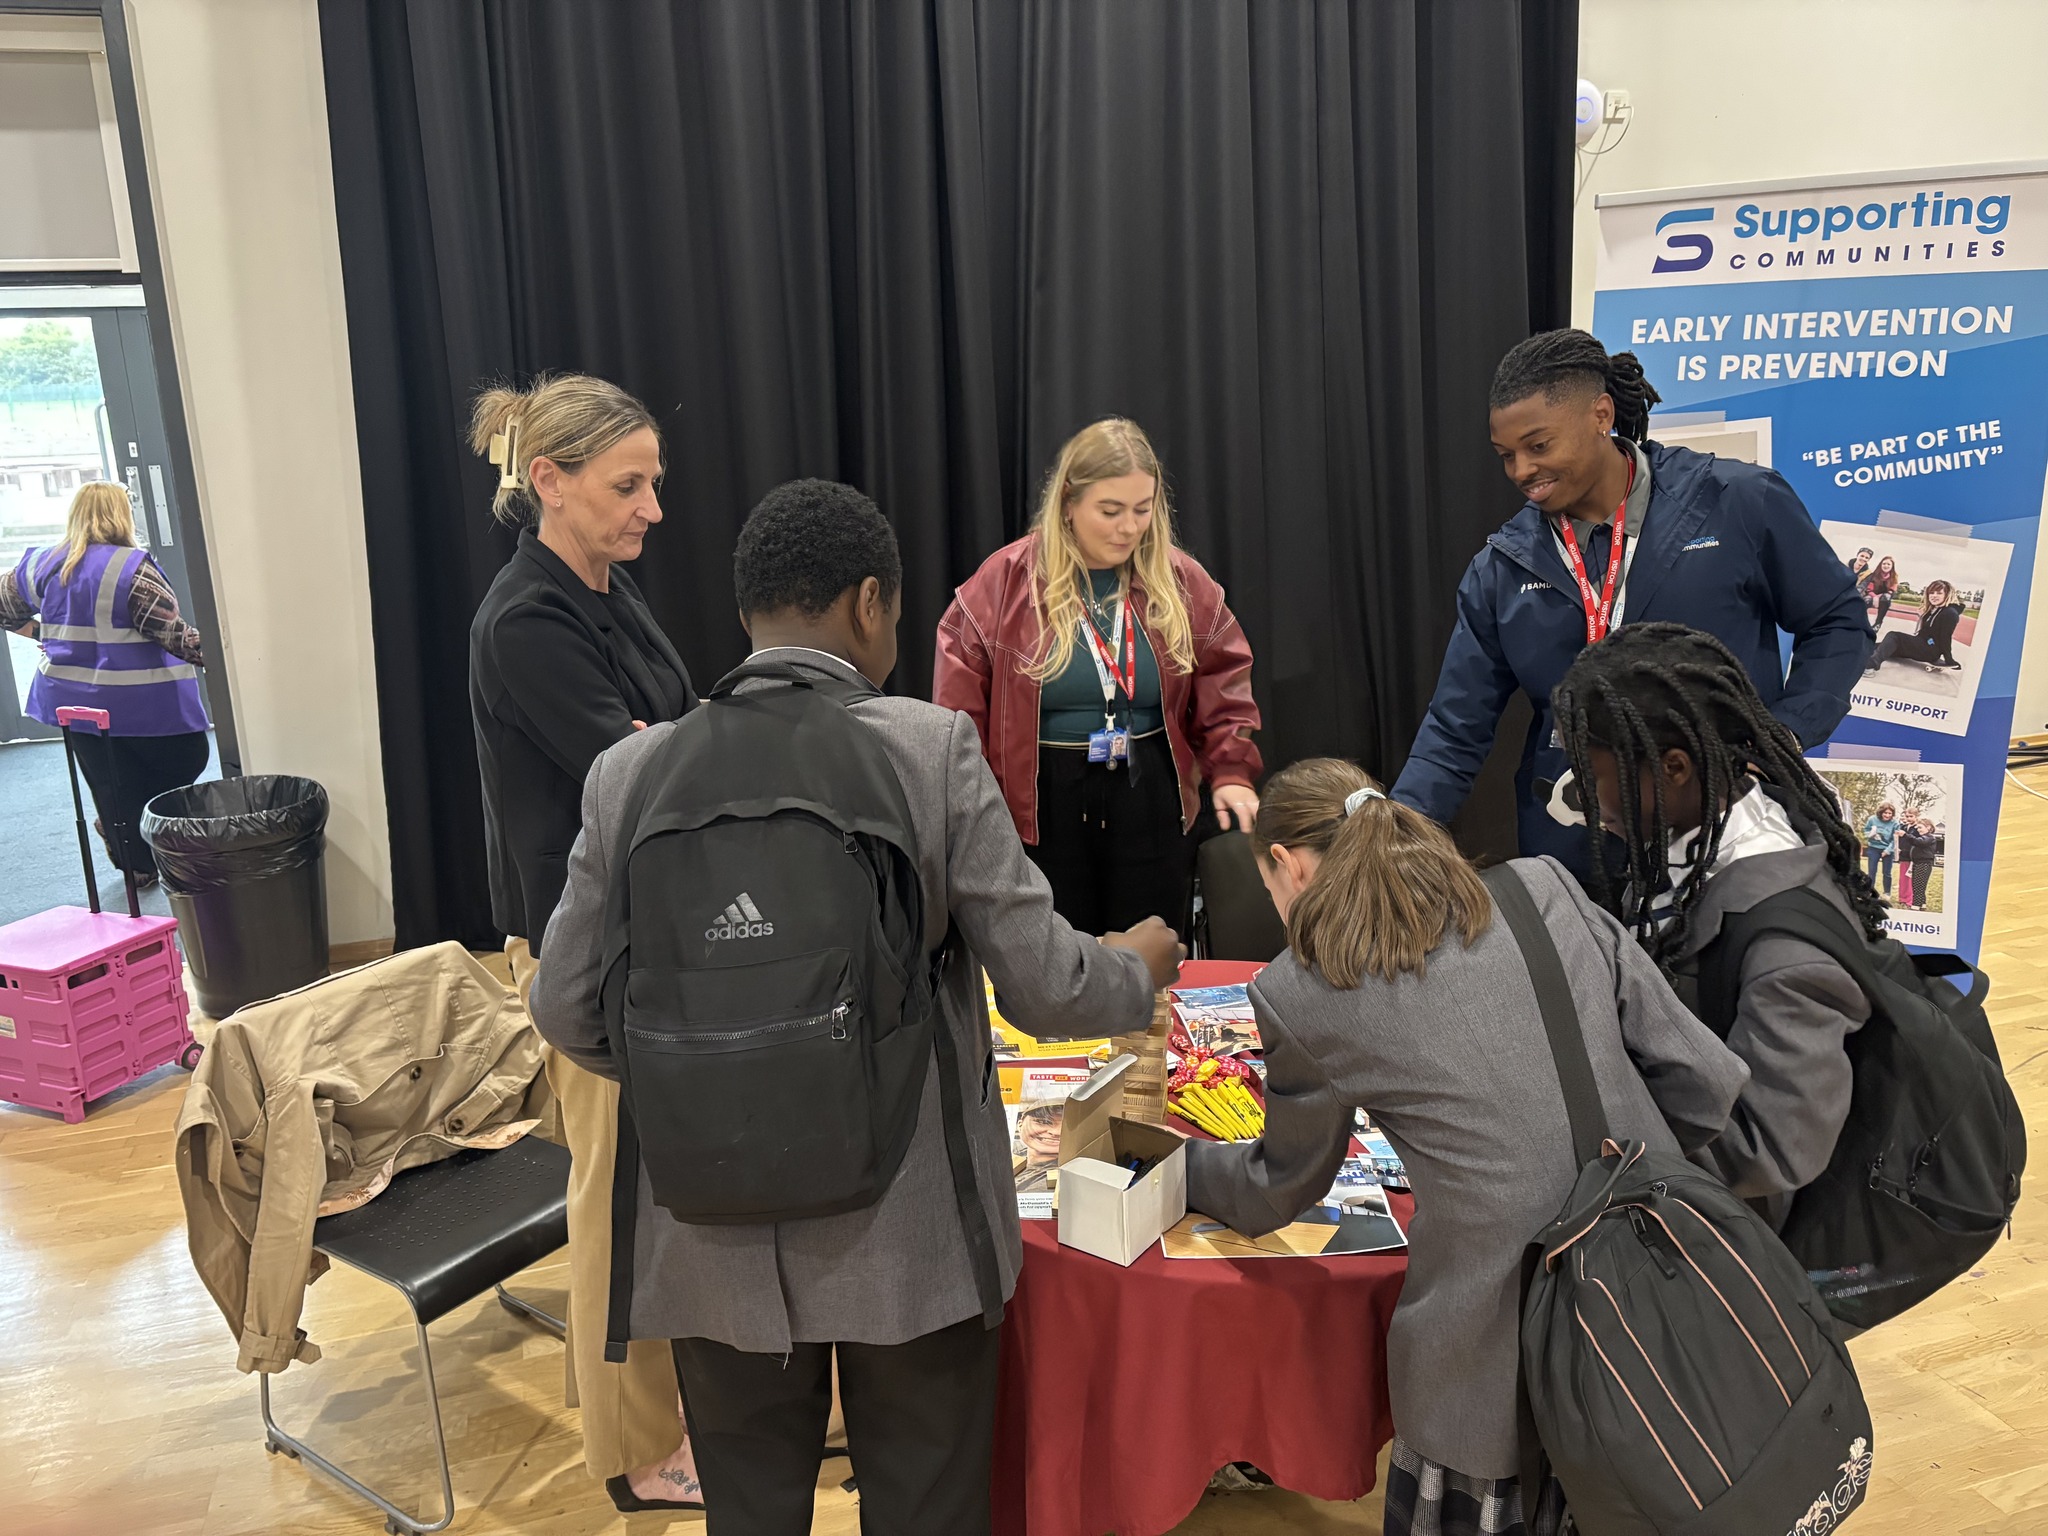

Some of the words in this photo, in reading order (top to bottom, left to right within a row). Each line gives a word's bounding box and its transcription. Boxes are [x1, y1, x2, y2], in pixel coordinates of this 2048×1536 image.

[1733, 191, 2012, 242] Supporting
[1730, 240, 2006, 270] COMMUNITIES
[1631, 315, 1732, 344] EARLY
[1743, 305, 2014, 340] INTERVENTION
[1677, 355, 1707, 381] IS
[1719, 349, 1948, 380] PREVENTION
[1850, 435, 1908, 461] PART
[1916, 428, 1948, 449] OF
[1955, 419, 2001, 443] THE
[1614, 520, 1623, 546] VISITOR
[1609, 559, 1619, 585] VISITOR
[1580, 576, 1591, 601] VISITOR
[1599, 600, 1610, 626] VISITOR
[1589, 614, 1597, 641] VISITOR
[1852, 693, 1882, 707] NITY
[1886, 700, 1949, 720] SUPPORT
[704, 920, 774, 941] adidas
